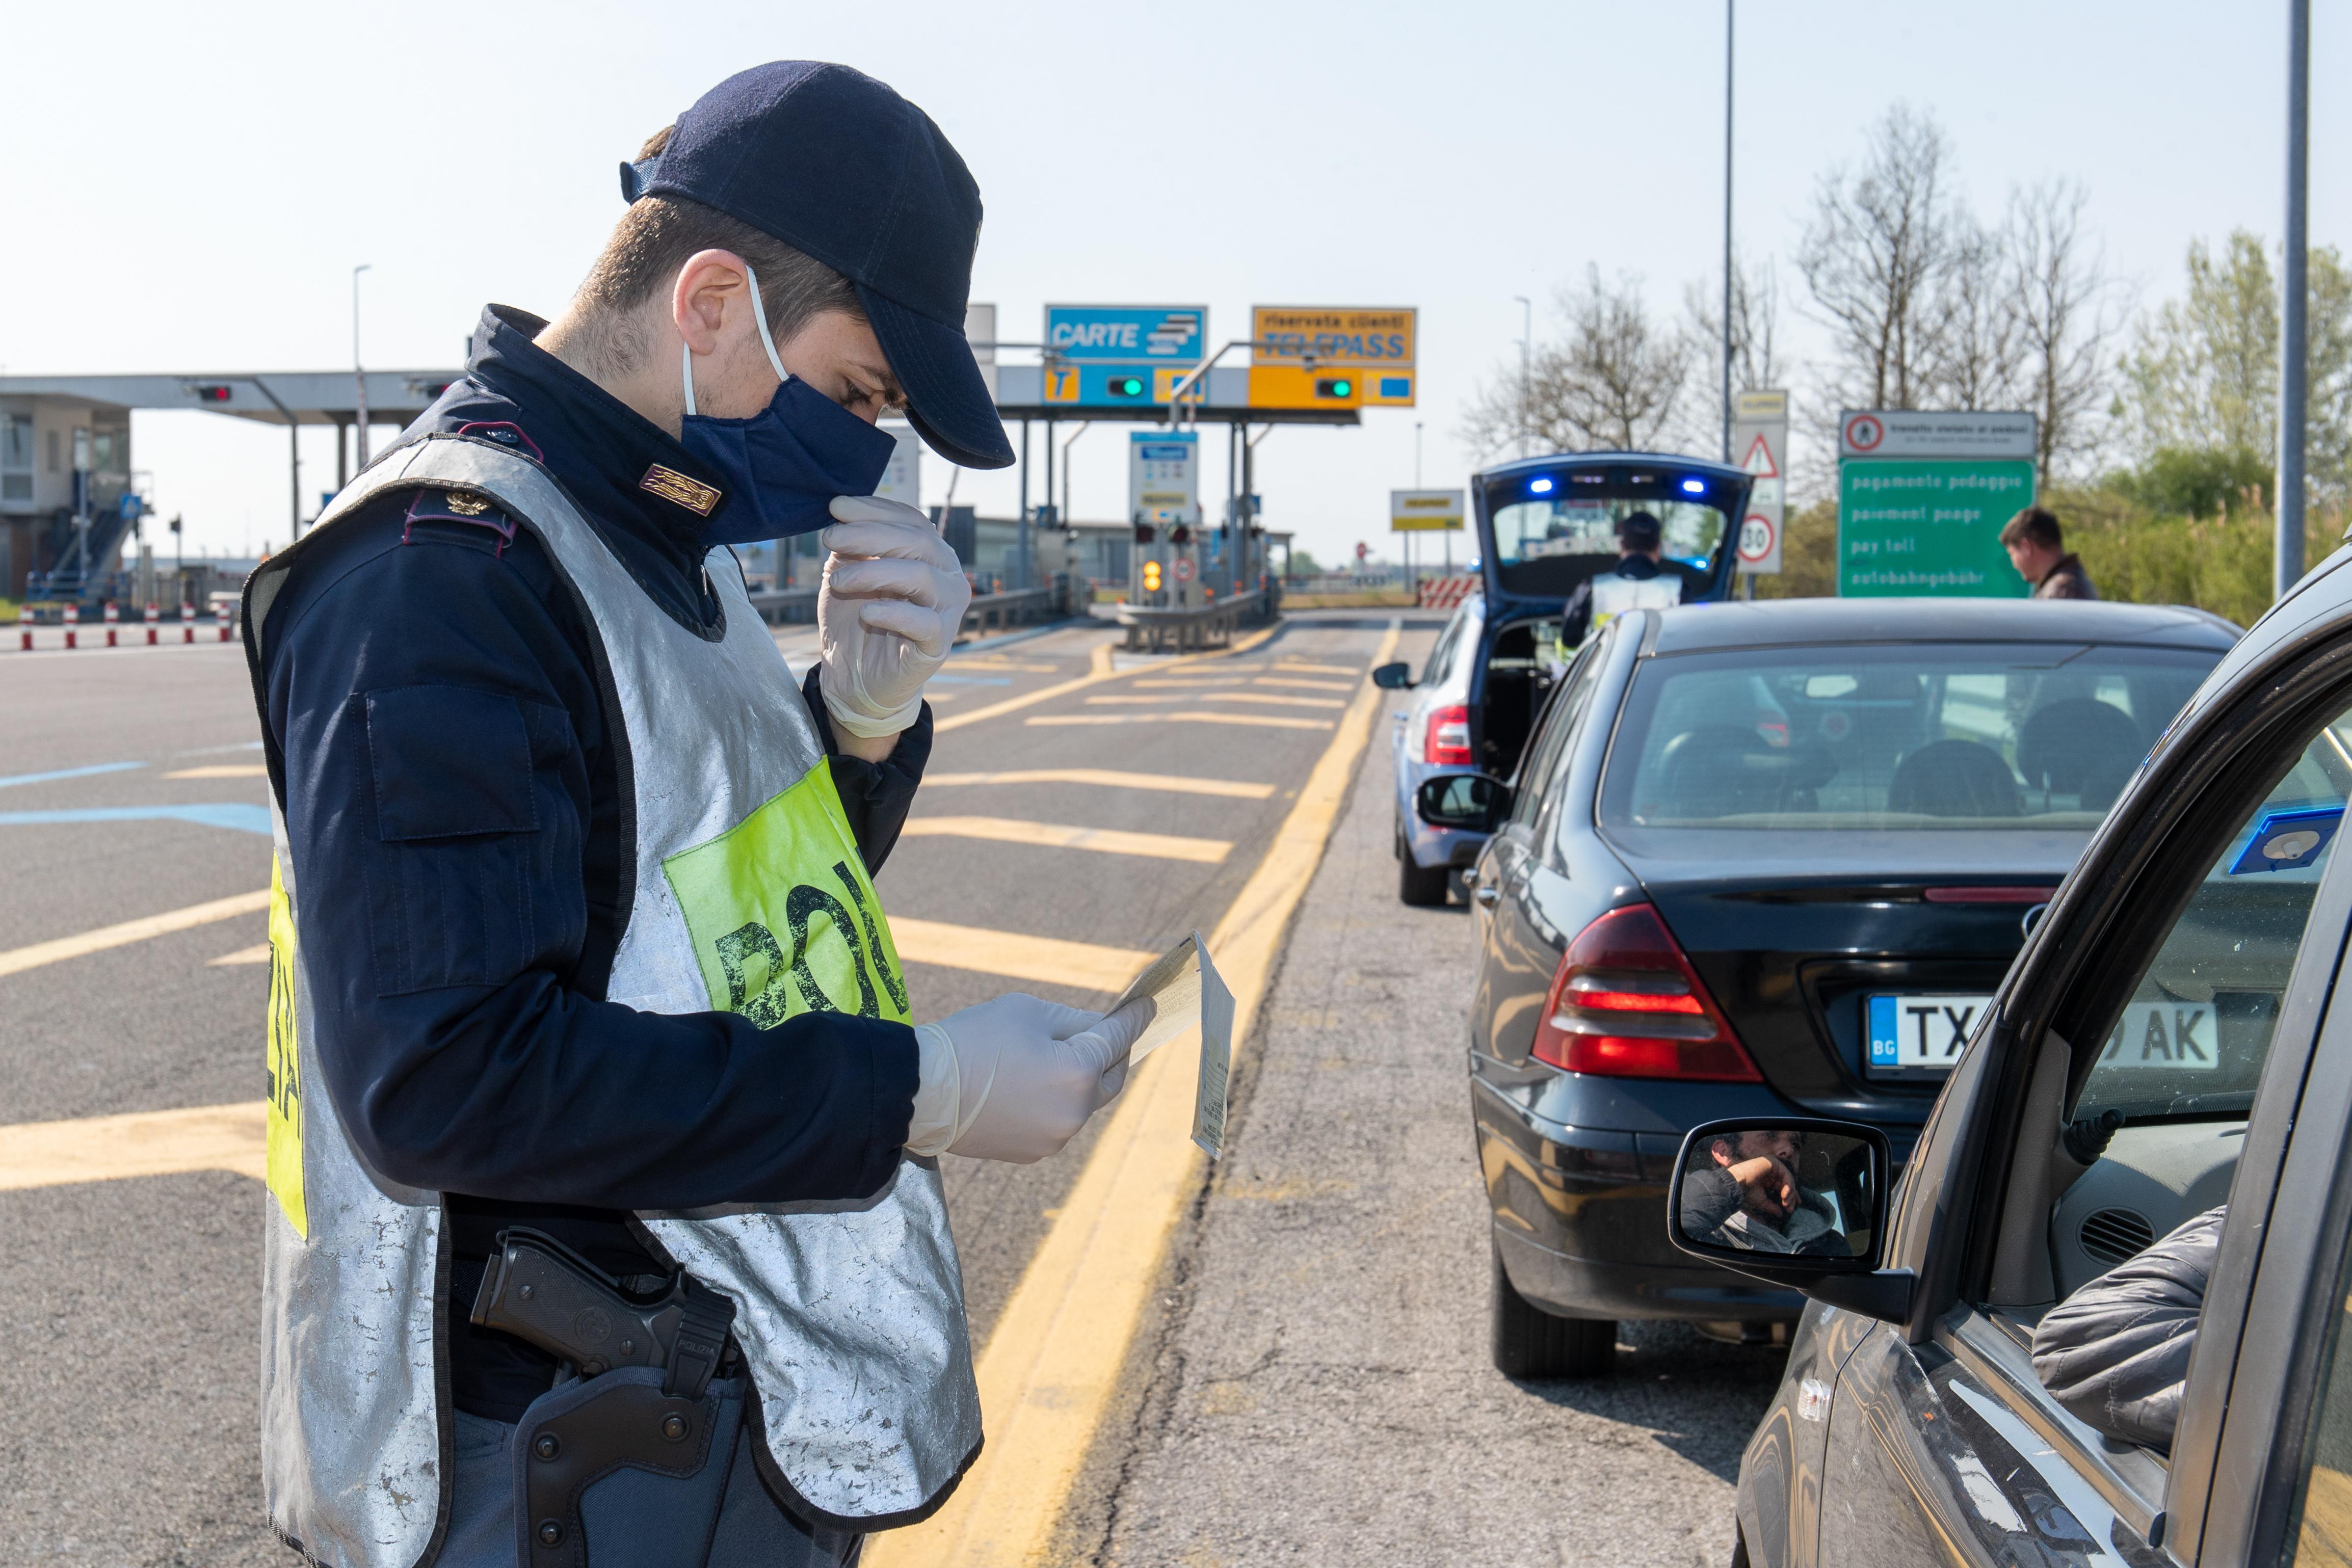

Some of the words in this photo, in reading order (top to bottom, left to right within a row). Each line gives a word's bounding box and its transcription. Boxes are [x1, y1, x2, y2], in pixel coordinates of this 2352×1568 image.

[1052, 322, 1141, 348] CARTE
[1263, 333, 1405, 358] TELEPASS
[1852, 474, 1942, 492] pagamento
[1743, 526, 1766, 550] 30
[1851, 542, 1878, 555] pay
[1886, 538, 1914, 551] toll
[1907, 1006, 1974, 1057] TX
[2141, 1009, 2208, 1060] AK
[1872, 1040, 1896, 1055] BG
[677, 1339, 715, 1355] POLIZIA
